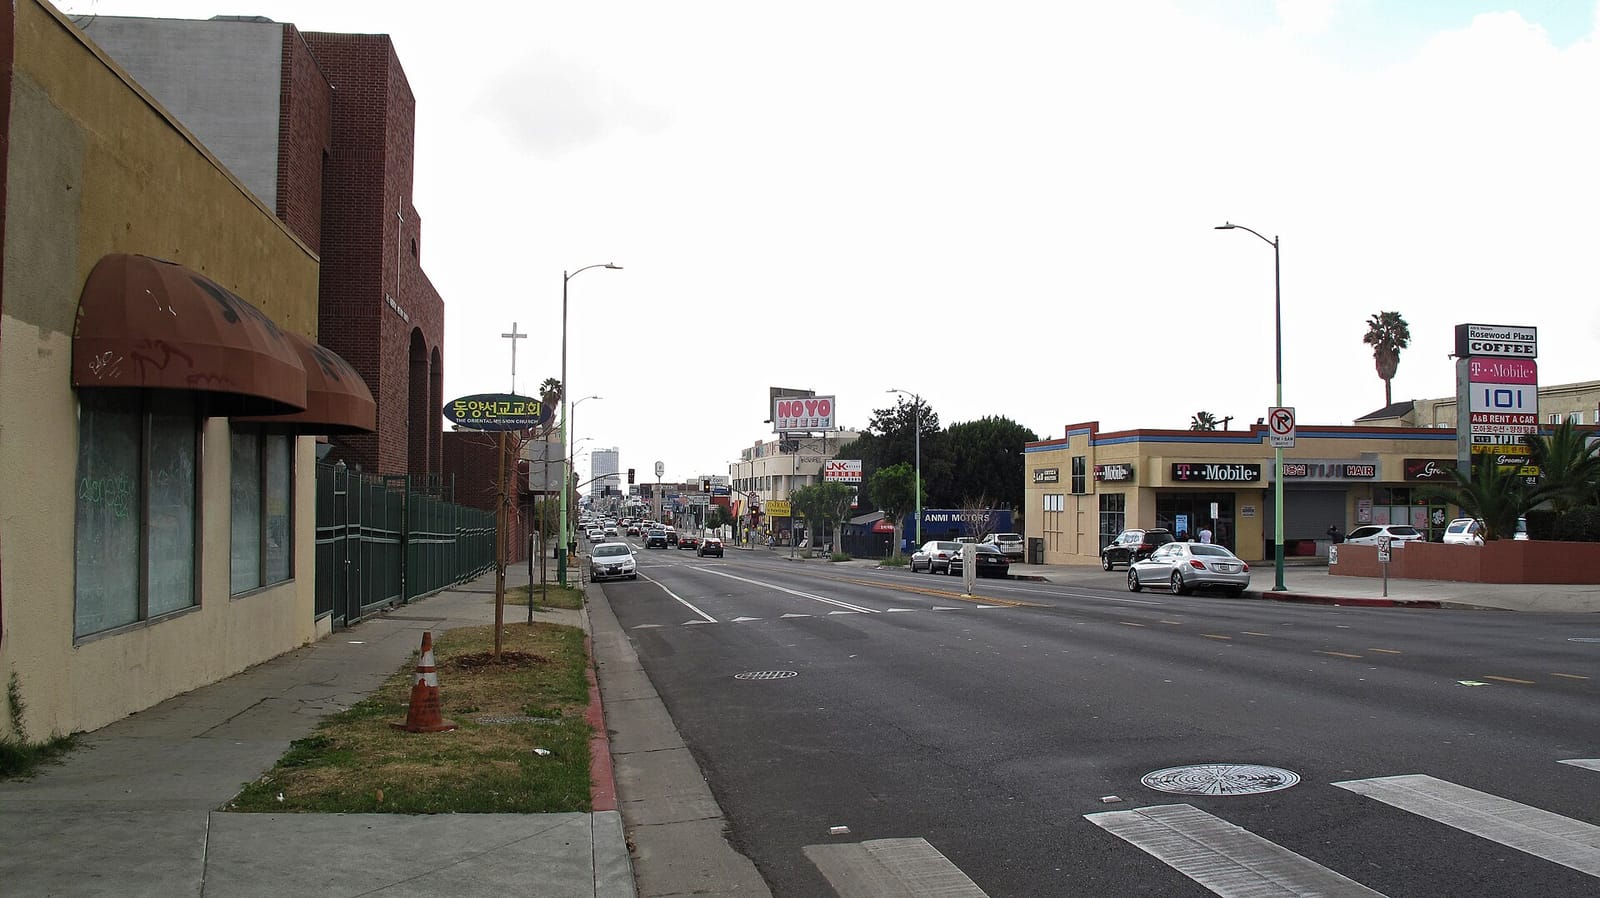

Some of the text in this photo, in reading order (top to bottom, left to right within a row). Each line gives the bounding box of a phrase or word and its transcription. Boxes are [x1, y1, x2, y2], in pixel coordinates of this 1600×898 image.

[1470, 330, 1510, 340] Rosewood
[1471, 342, 1534, 353] COFFEE
[453, 400, 541, 418] 동양선교교회
[778, 399, 831, 418] NOYO
[1472, 414, 1535, 424] A&B RENT A CAR
[1494, 435, 1515, 444] TIJI
[1346, 465, 1374, 476] HAIR
[924, 513, 990, 522] ANMI MOTORS
